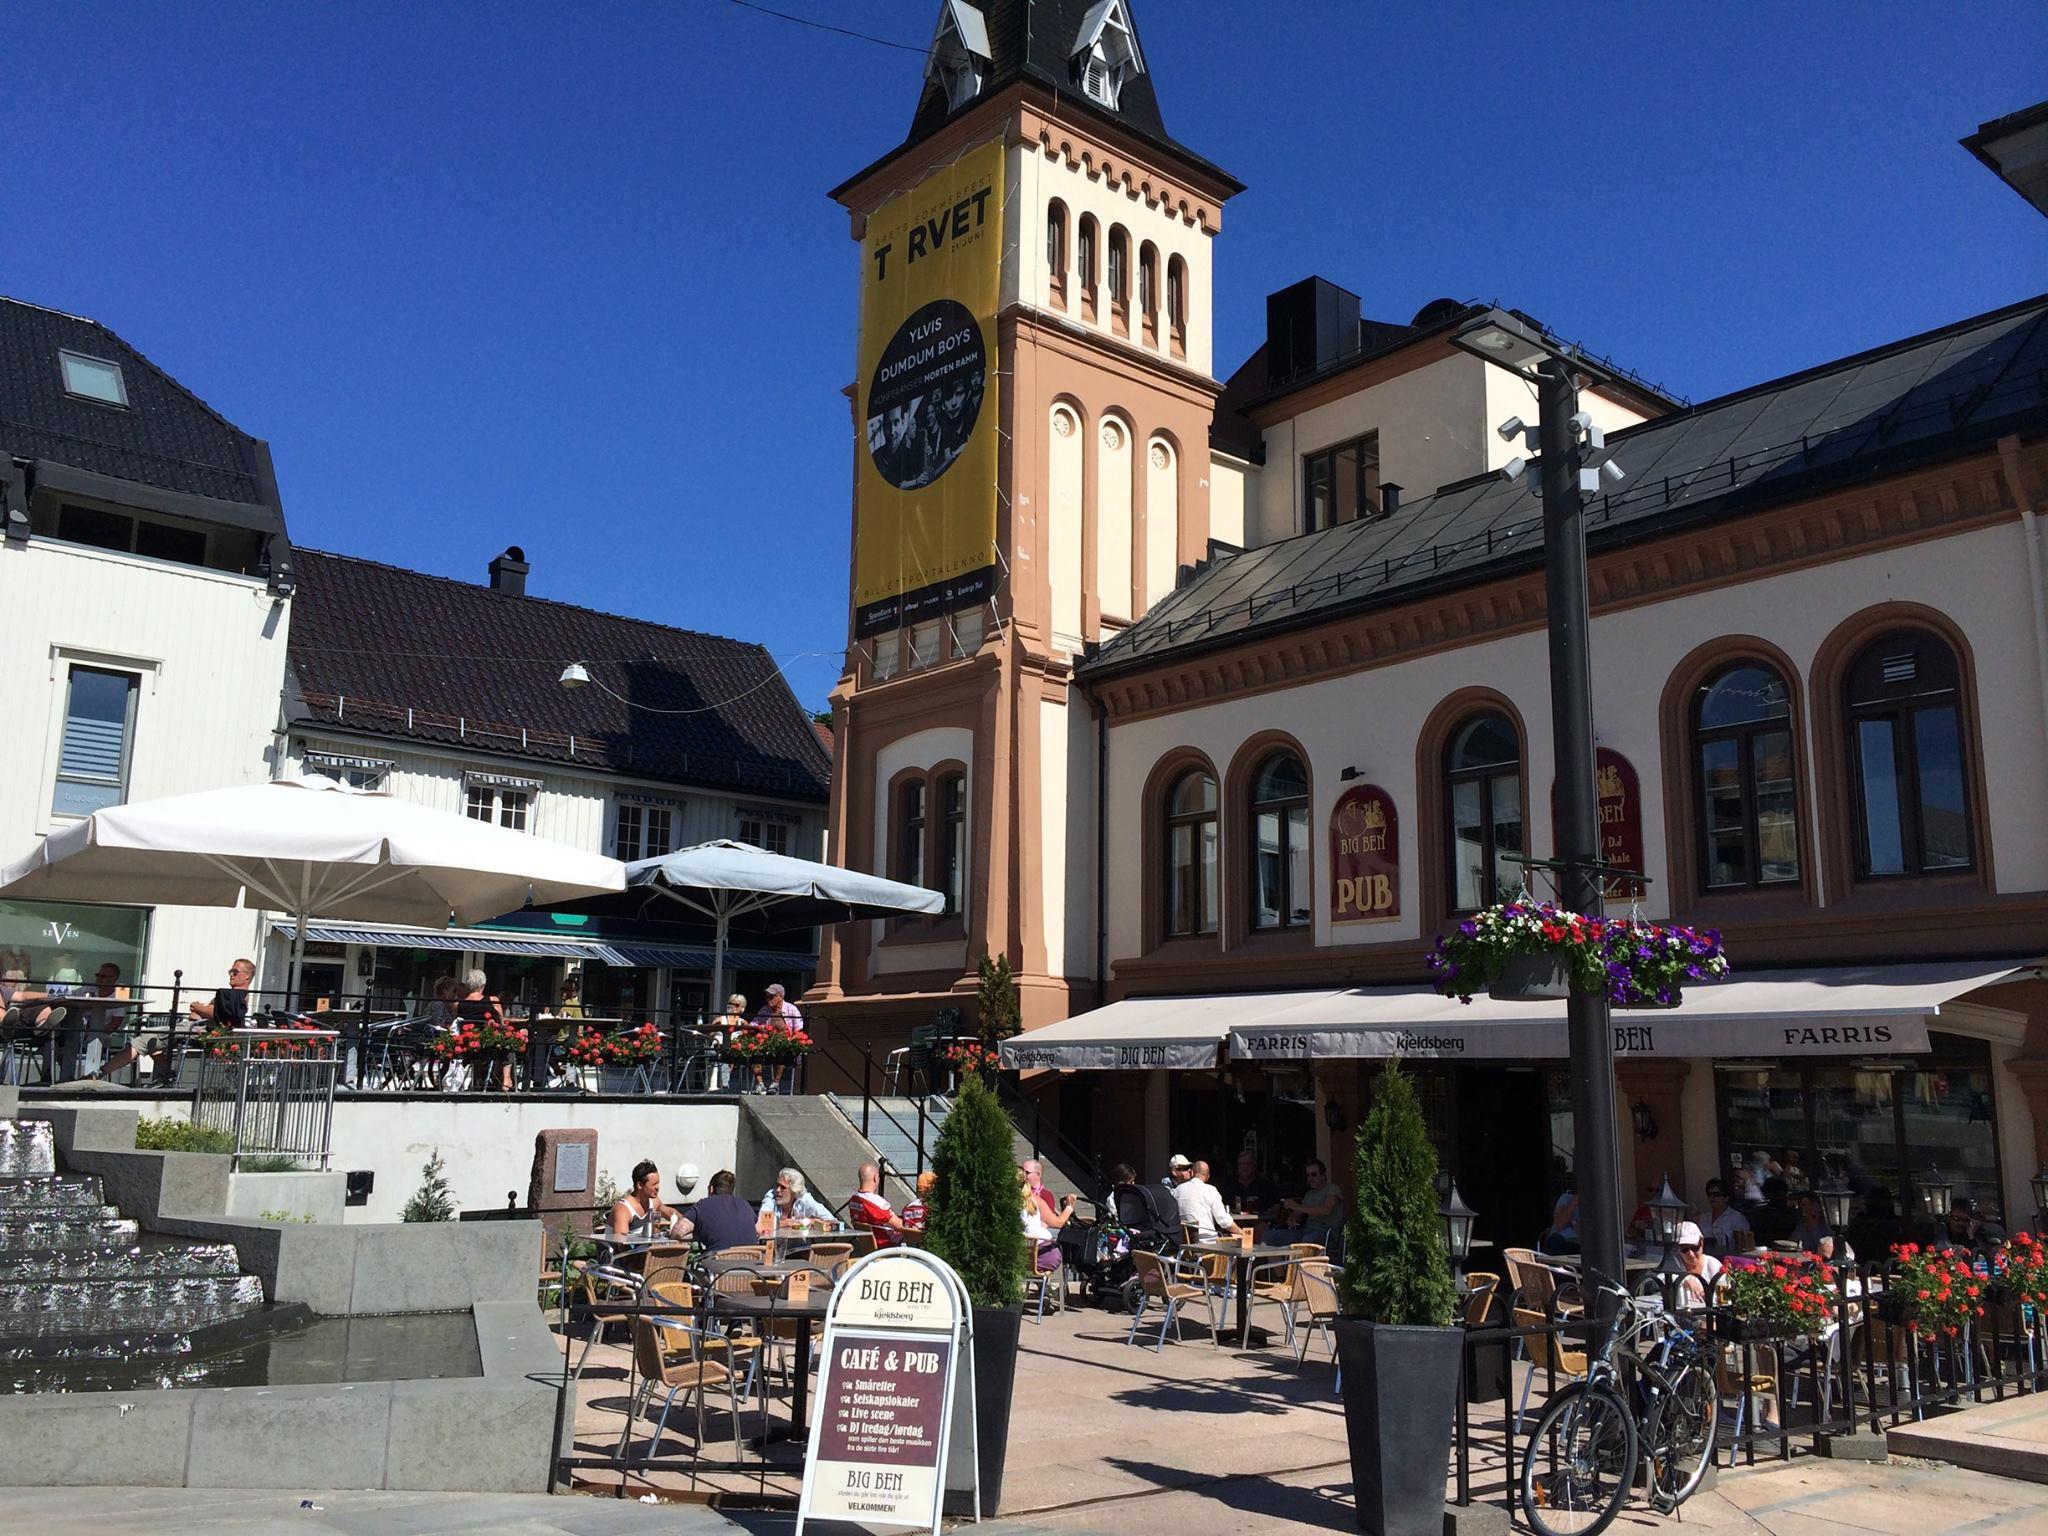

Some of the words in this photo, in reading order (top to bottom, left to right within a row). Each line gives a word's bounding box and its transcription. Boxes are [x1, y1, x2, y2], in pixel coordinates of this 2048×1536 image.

[909, 317, 943, 343] YLVIS
[881, 345, 935, 382] DUMDUM
[938, 328, 971, 355] BOYS
[924, 362, 955, 383] MORTEN
[956, 351, 978, 368] RAMM
[1341, 837, 1359, 855] BIG
[1362, 833, 1386, 852] BEN
[1337, 874, 1393, 913] PUB
[1247, 1036, 1307, 1051] FARRIS
[1396, 1034, 1464, 1052] kjeldsberg
[1614, 1027, 1654, 1051] BEN
[1784, 1026, 1892, 1045] FARRIS
[1014, 1049, 1055, 1063] kjeldsberg
[1121, 1047, 1139, 1064] BIG
[1142, 1046, 1166, 1064] BEN
[793, 1274, 806, 1282] 13
[860, 1278, 891, 1302] BIG
[896, 1280, 934, 1304] BEN
[874, 1310, 914, 1322] kjeldsberg
[840, 1346, 880, 1370] CAFÉ
[884, 1350, 899, 1371] &
[903, 1351, 940, 1374] PUB
[854, 1378, 897, 1392] Småretter
[852, 1393, 920, 1408] Selskapslokaler
[851, 1407, 869, 1419] Live
[870, 1410, 895, 1421] scene
[849, 1421, 860, 1434] DJ
[861, 1423, 924, 1439] fredag/lørdag
[846, 1470, 871, 1489] BIG
[874, 1472, 904, 1491] BEN
[848, 1502, 896, 1513] VELKOMMEN!
